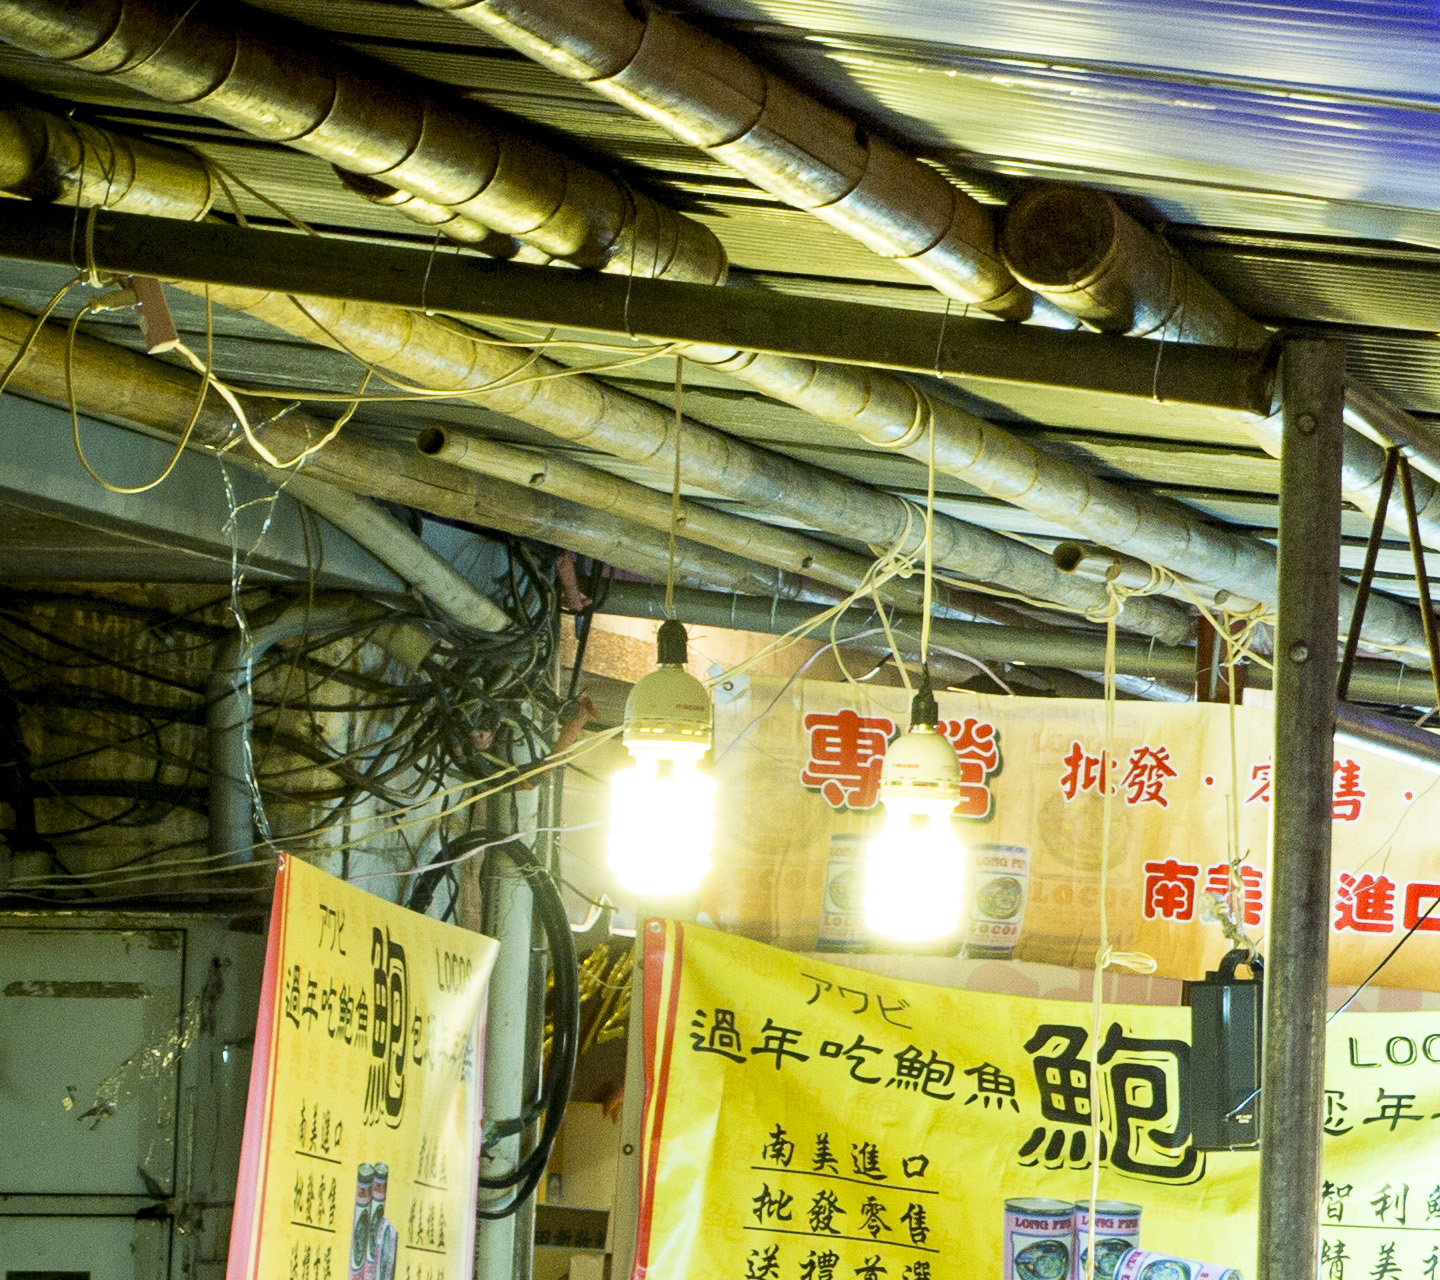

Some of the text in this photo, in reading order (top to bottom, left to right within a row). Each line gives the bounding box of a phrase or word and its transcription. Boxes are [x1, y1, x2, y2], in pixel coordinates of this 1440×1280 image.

[1061, 741, 1176, 808] 批發
[363, 924, 409, 1129] 鮑
[801, 973, 913, 1030] アワビ
[689, 1006, 1021, 1114] 過年吃鮑魚
[1017, 1022, 1207, 1186] 鮑
[761, 1124, 930, 1181] 南美進口
[754, 1184, 932, 1247] 批發零售
